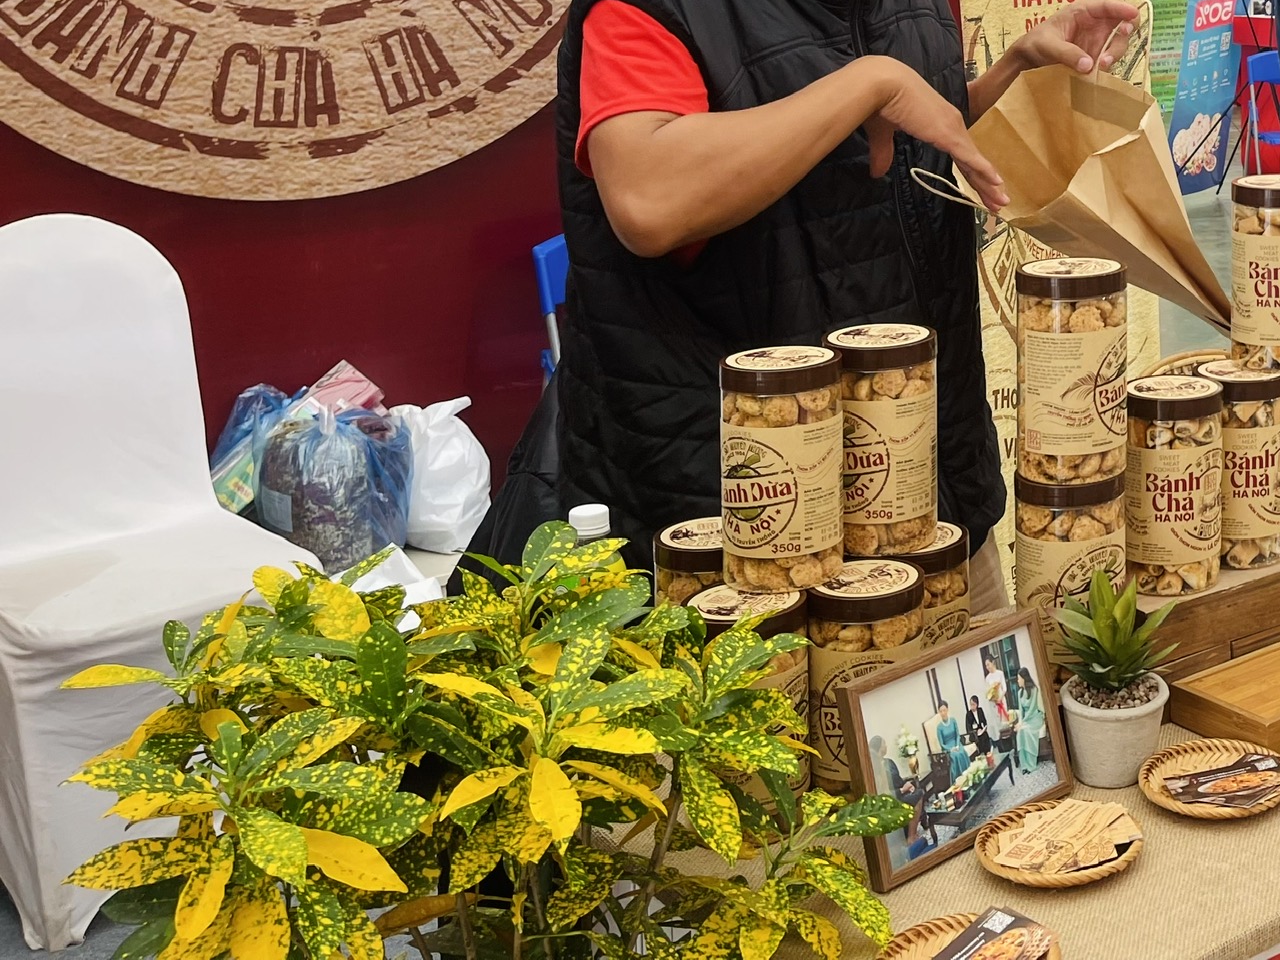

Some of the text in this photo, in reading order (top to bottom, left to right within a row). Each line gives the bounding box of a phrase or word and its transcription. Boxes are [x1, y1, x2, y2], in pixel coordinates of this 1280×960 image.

[1099, 375, 1127, 408] Bán
[846, 450, 885, 470] Dừa
[1224, 449, 1275, 470] Bánh
[1145, 472, 1200, 492] Bánh
[1230, 469, 1270, 488] Chả
[723, 481, 792, 504] ánh Dừa
[1152, 491, 1194, 512] Chả
[864, 509, 893, 520] 350g
[750, 515, 777, 535] NỘI
[771, 543, 801, 554] 350g
